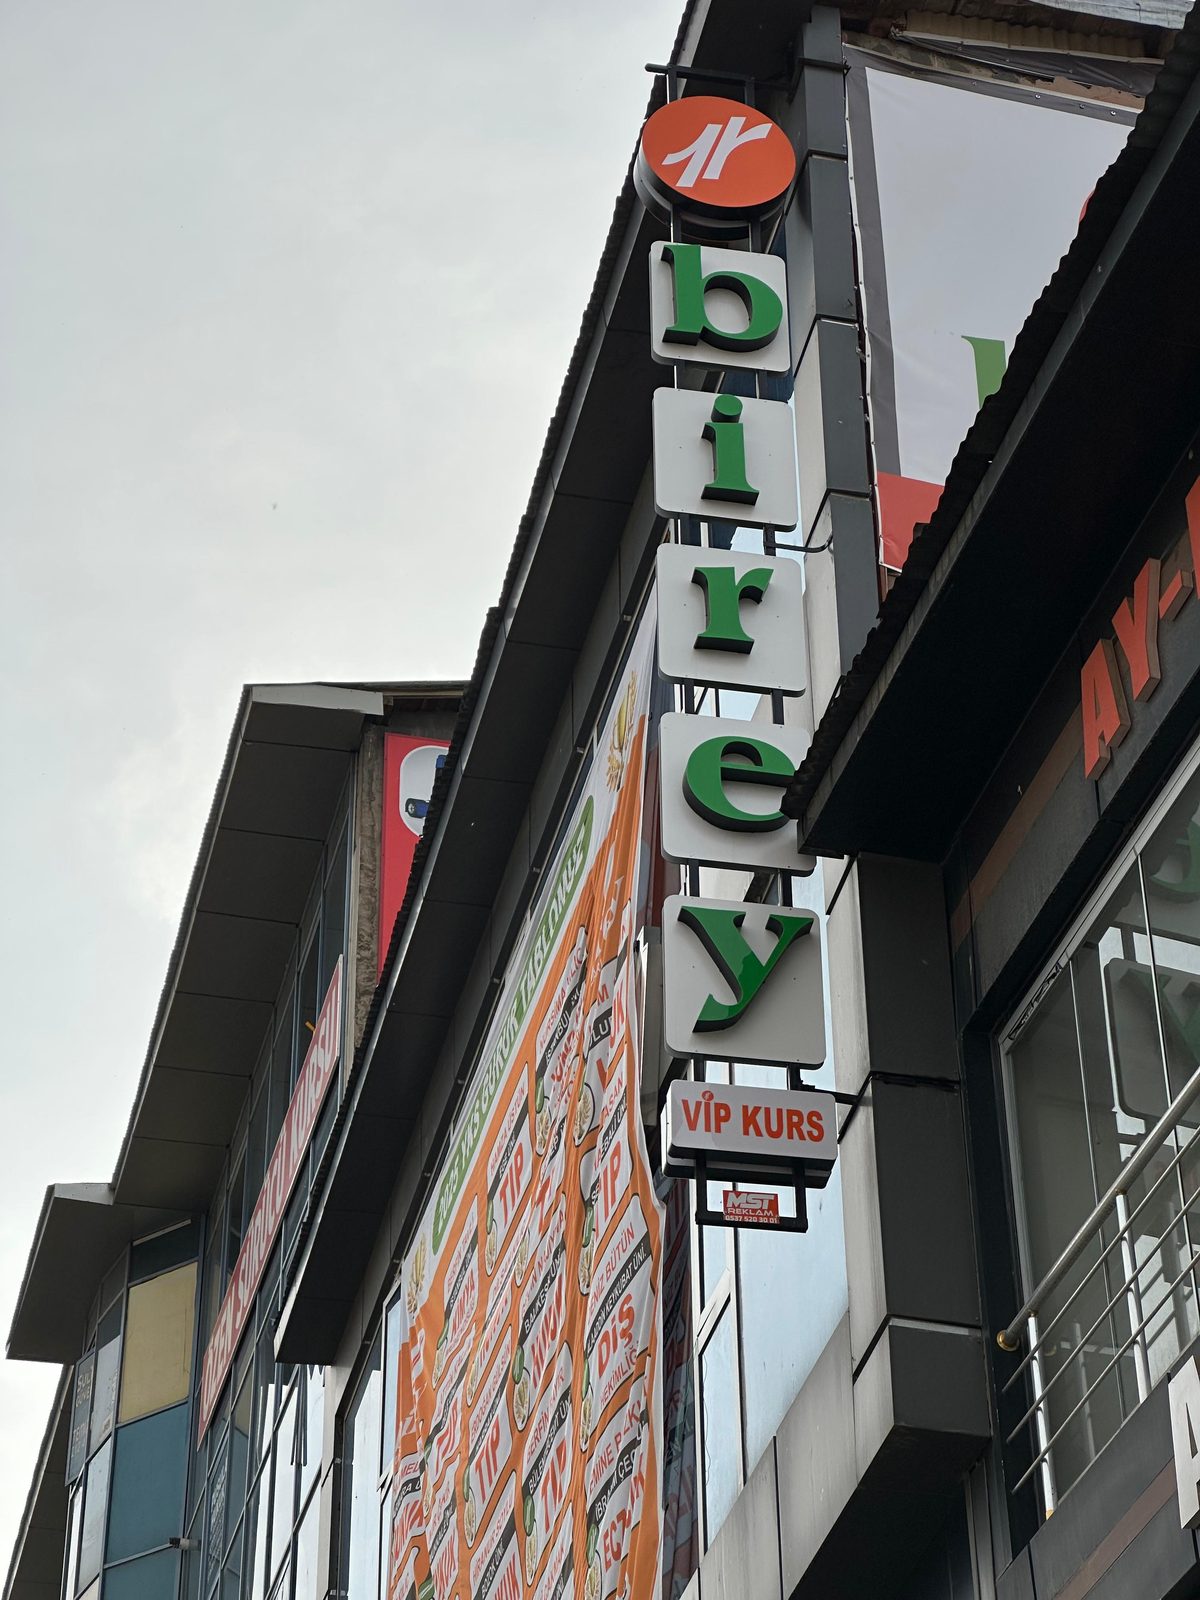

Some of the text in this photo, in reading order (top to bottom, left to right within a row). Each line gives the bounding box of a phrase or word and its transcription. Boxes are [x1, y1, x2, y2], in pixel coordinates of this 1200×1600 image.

[481, 998, 519, 1113] GURUR
[742, 1104, 825, 1143] KURS
[201, 985, 335, 1422] ÖZEN SÜRÜCÜ KURSU
[499, 1142, 524, 1227] TIP
[726, 1192, 774, 1209] MST
[728, 1207, 774, 1216] REKLAM
[605, 1226, 635, 1279] BÜTÜN
[598, 1294, 635, 1377] DİŞ
[475, 1415, 500, 1504] TIP
[541, 1439, 566, 1534] TIP
